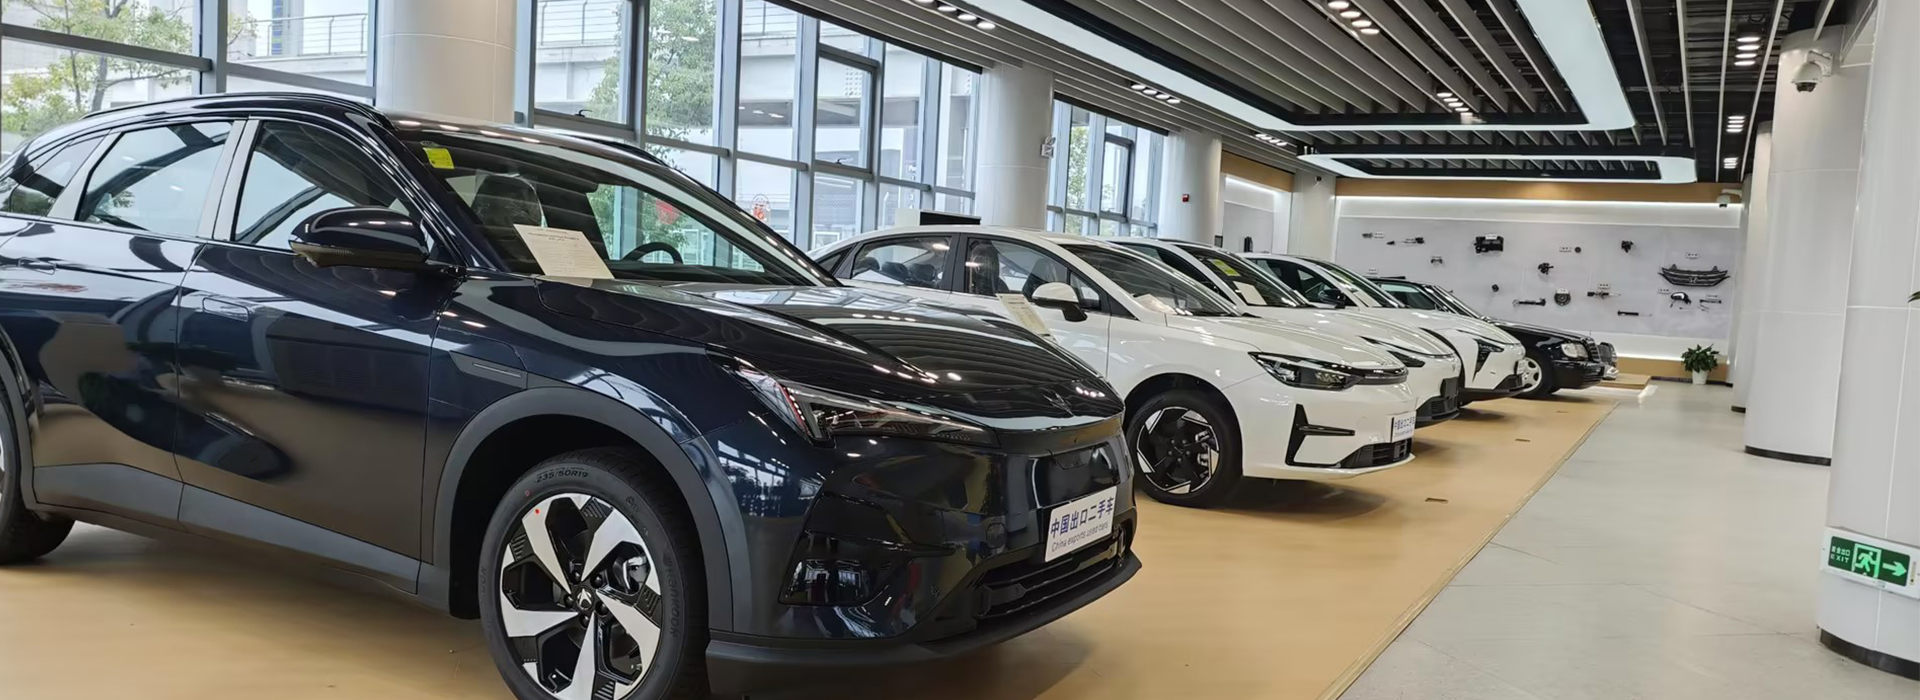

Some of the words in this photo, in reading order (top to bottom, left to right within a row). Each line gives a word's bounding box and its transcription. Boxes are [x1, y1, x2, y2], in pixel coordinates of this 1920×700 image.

[535, 469, 589, 483] 235/50R19
[1050, 497, 1115, 539] 中国出口二手车
[1052, 540, 1067, 552] China
[1830, 553, 1849, 563] EXIT
